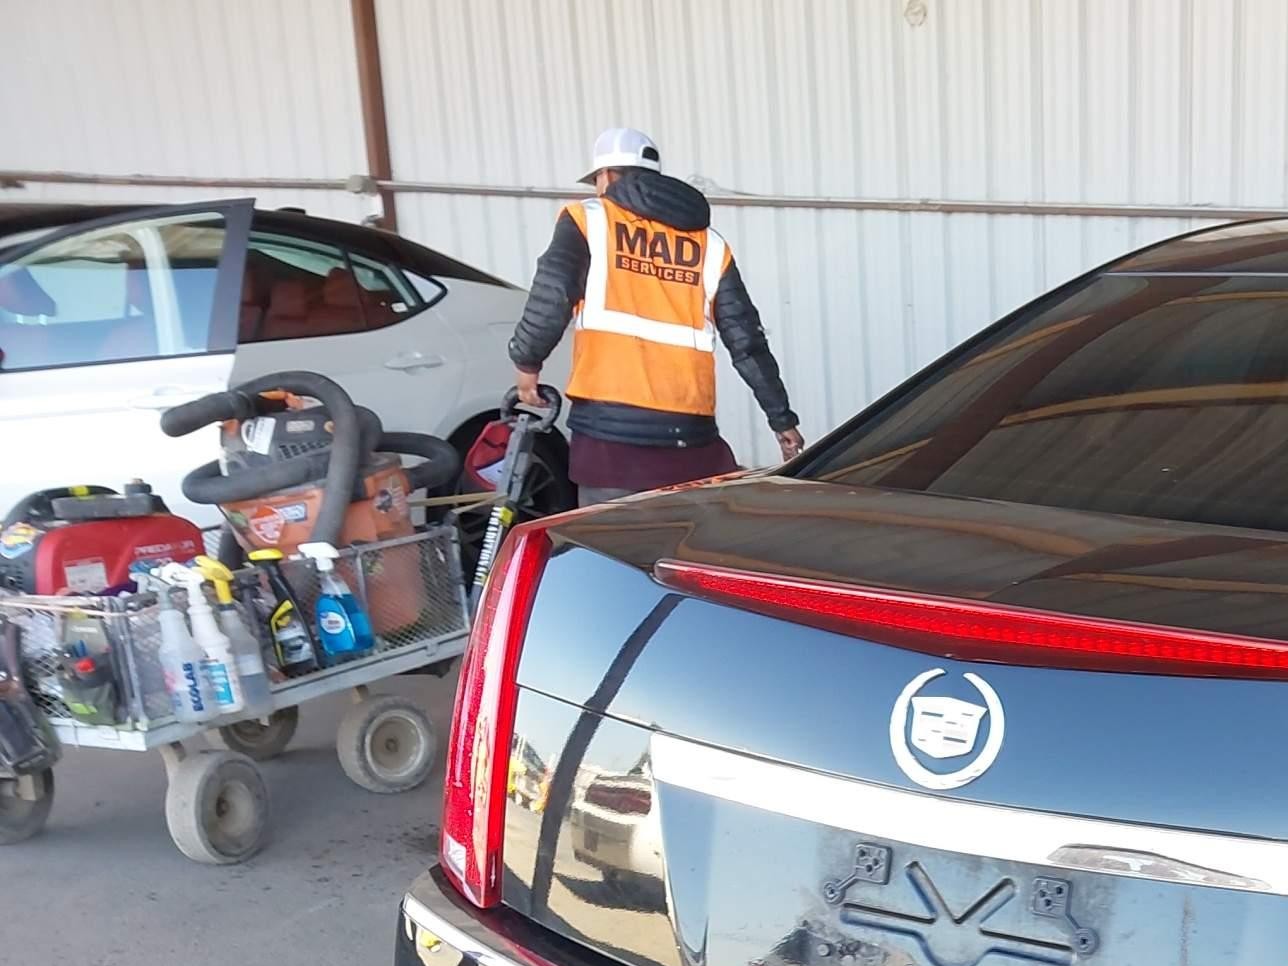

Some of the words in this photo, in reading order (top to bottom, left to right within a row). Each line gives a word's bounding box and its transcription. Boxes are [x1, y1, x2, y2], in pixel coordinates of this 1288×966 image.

[615, 222, 700, 268] MAD
[621, 256, 695, 284] SERVICES
[182, 663, 204, 712] ECOLAB
